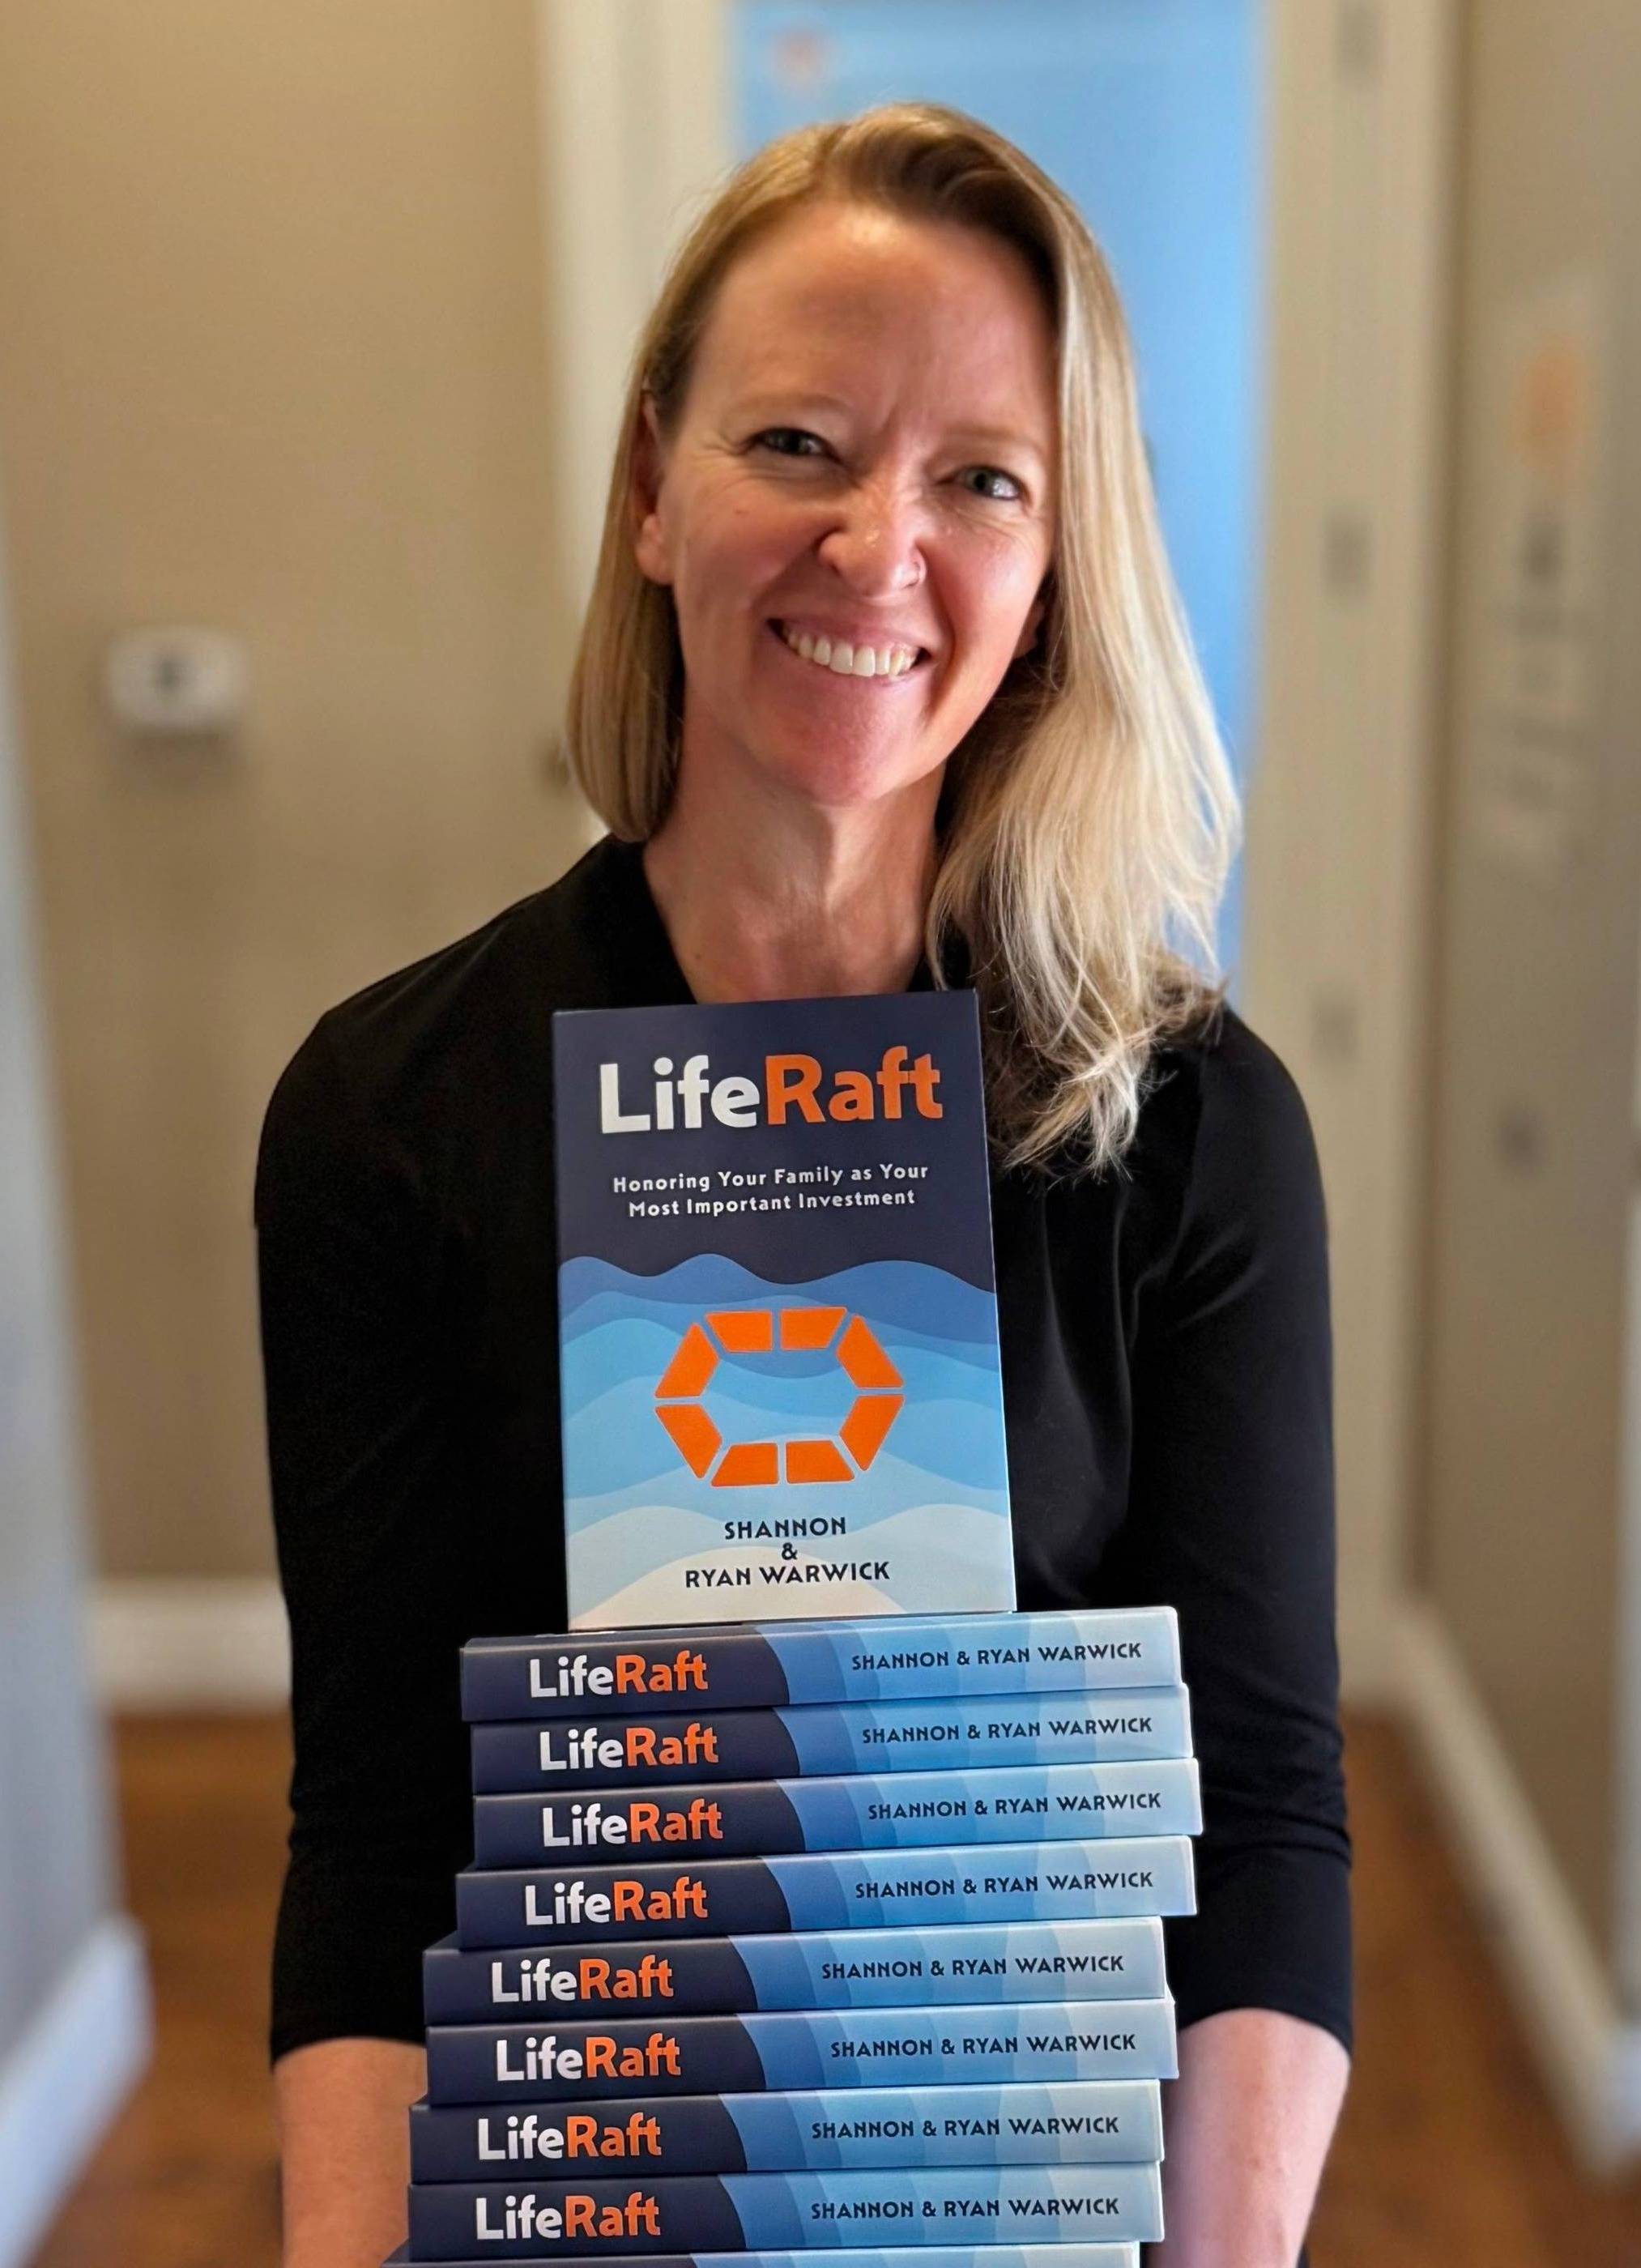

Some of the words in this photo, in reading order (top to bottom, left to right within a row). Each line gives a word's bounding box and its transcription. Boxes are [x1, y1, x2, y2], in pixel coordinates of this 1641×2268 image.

[599, 1046, 943, 1134] LifeRaft
[613, 1173, 710, 1193] Honoring
[718, 1170, 767, 1187] Your
[774, 1166, 843, 1186] Family
[850, 1168, 872, 1181] as
[879, 1163, 928, 1179] Your
[629, 1200, 680, 1217] Most
[687, 1196, 791, 1217] Important
[799, 1189, 915, 1209] Investment
[724, 1516, 846, 1540] SHANNON
[781, 1542, 798, 1561] &
[685, 1567, 751, 1588] RYAN
[758, 1561, 890, 1584] WARWICK
[852, 1651, 949, 1670] SHANNON
[957, 1651, 970, 1665] &
[977, 1648, 1030, 1665] RYAN
[1038, 1643, 1141, 1661] WARWICK
[529, 1649, 709, 1698] LifeRaft
[862, 1724, 959, 1744] SHANNON
[967, 1724, 981, 1739] &
[987, 1721, 1040, 1739] RYAN
[1048, 1717, 1152, 1736] WARWICK
[539, 1722, 718, 1771] LifeRaft
[867, 1801, 966, 1820] SHANNON
[974, 1800, 988, 1815] &
[995, 1797, 1048, 1814] RYAN
[1055, 1793, 1161, 1811] WARWICK
[542, 1797, 723, 1847] LifeRaft
[855, 1879, 955, 1899] SHANNON
[963, 1878, 977, 1895] &
[984, 1876, 1038, 1893] RYAN
[1046, 1872, 1153, 1891] WARWICK
[525, 1876, 708, 1925] LifeRaft
[492, 1955, 674, 2003] LifeRaft
[821, 1961, 923, 1980] SHANNON
[930, 1960, 944, 1976] &
[952, 1959, 1007, 1976] RYAN
[1015, 1955, 1124, 1973] WARWICK
[497, 2032, 681, 2082] LifeRaft
[830, 2039, 932, 2058] SHANNON
[940, 2038, 955, 2055] &
[963, 2036, 1018, 2054] RYAN
[1026, 2034, 1136, 2053] WARWICK
[478, 2112, 662, 2160] LifeRaft
[812, 2121, 914, 2139] SHANNON
[923, 2120, 937, 2137] &
[944, 2118, 1000, 2136] RYAN
[1008, 2117, 1119, 2135] WARWICK
[475, 2191, 661, 2240] LifeRaft
[811, 2201, 914, 2219] SHANNON
[922, 2201, 936, 2218] &
[944, 2199, 1000, 2217] RYAN
[1008, 2198, 1119, 2216] WARWICK
